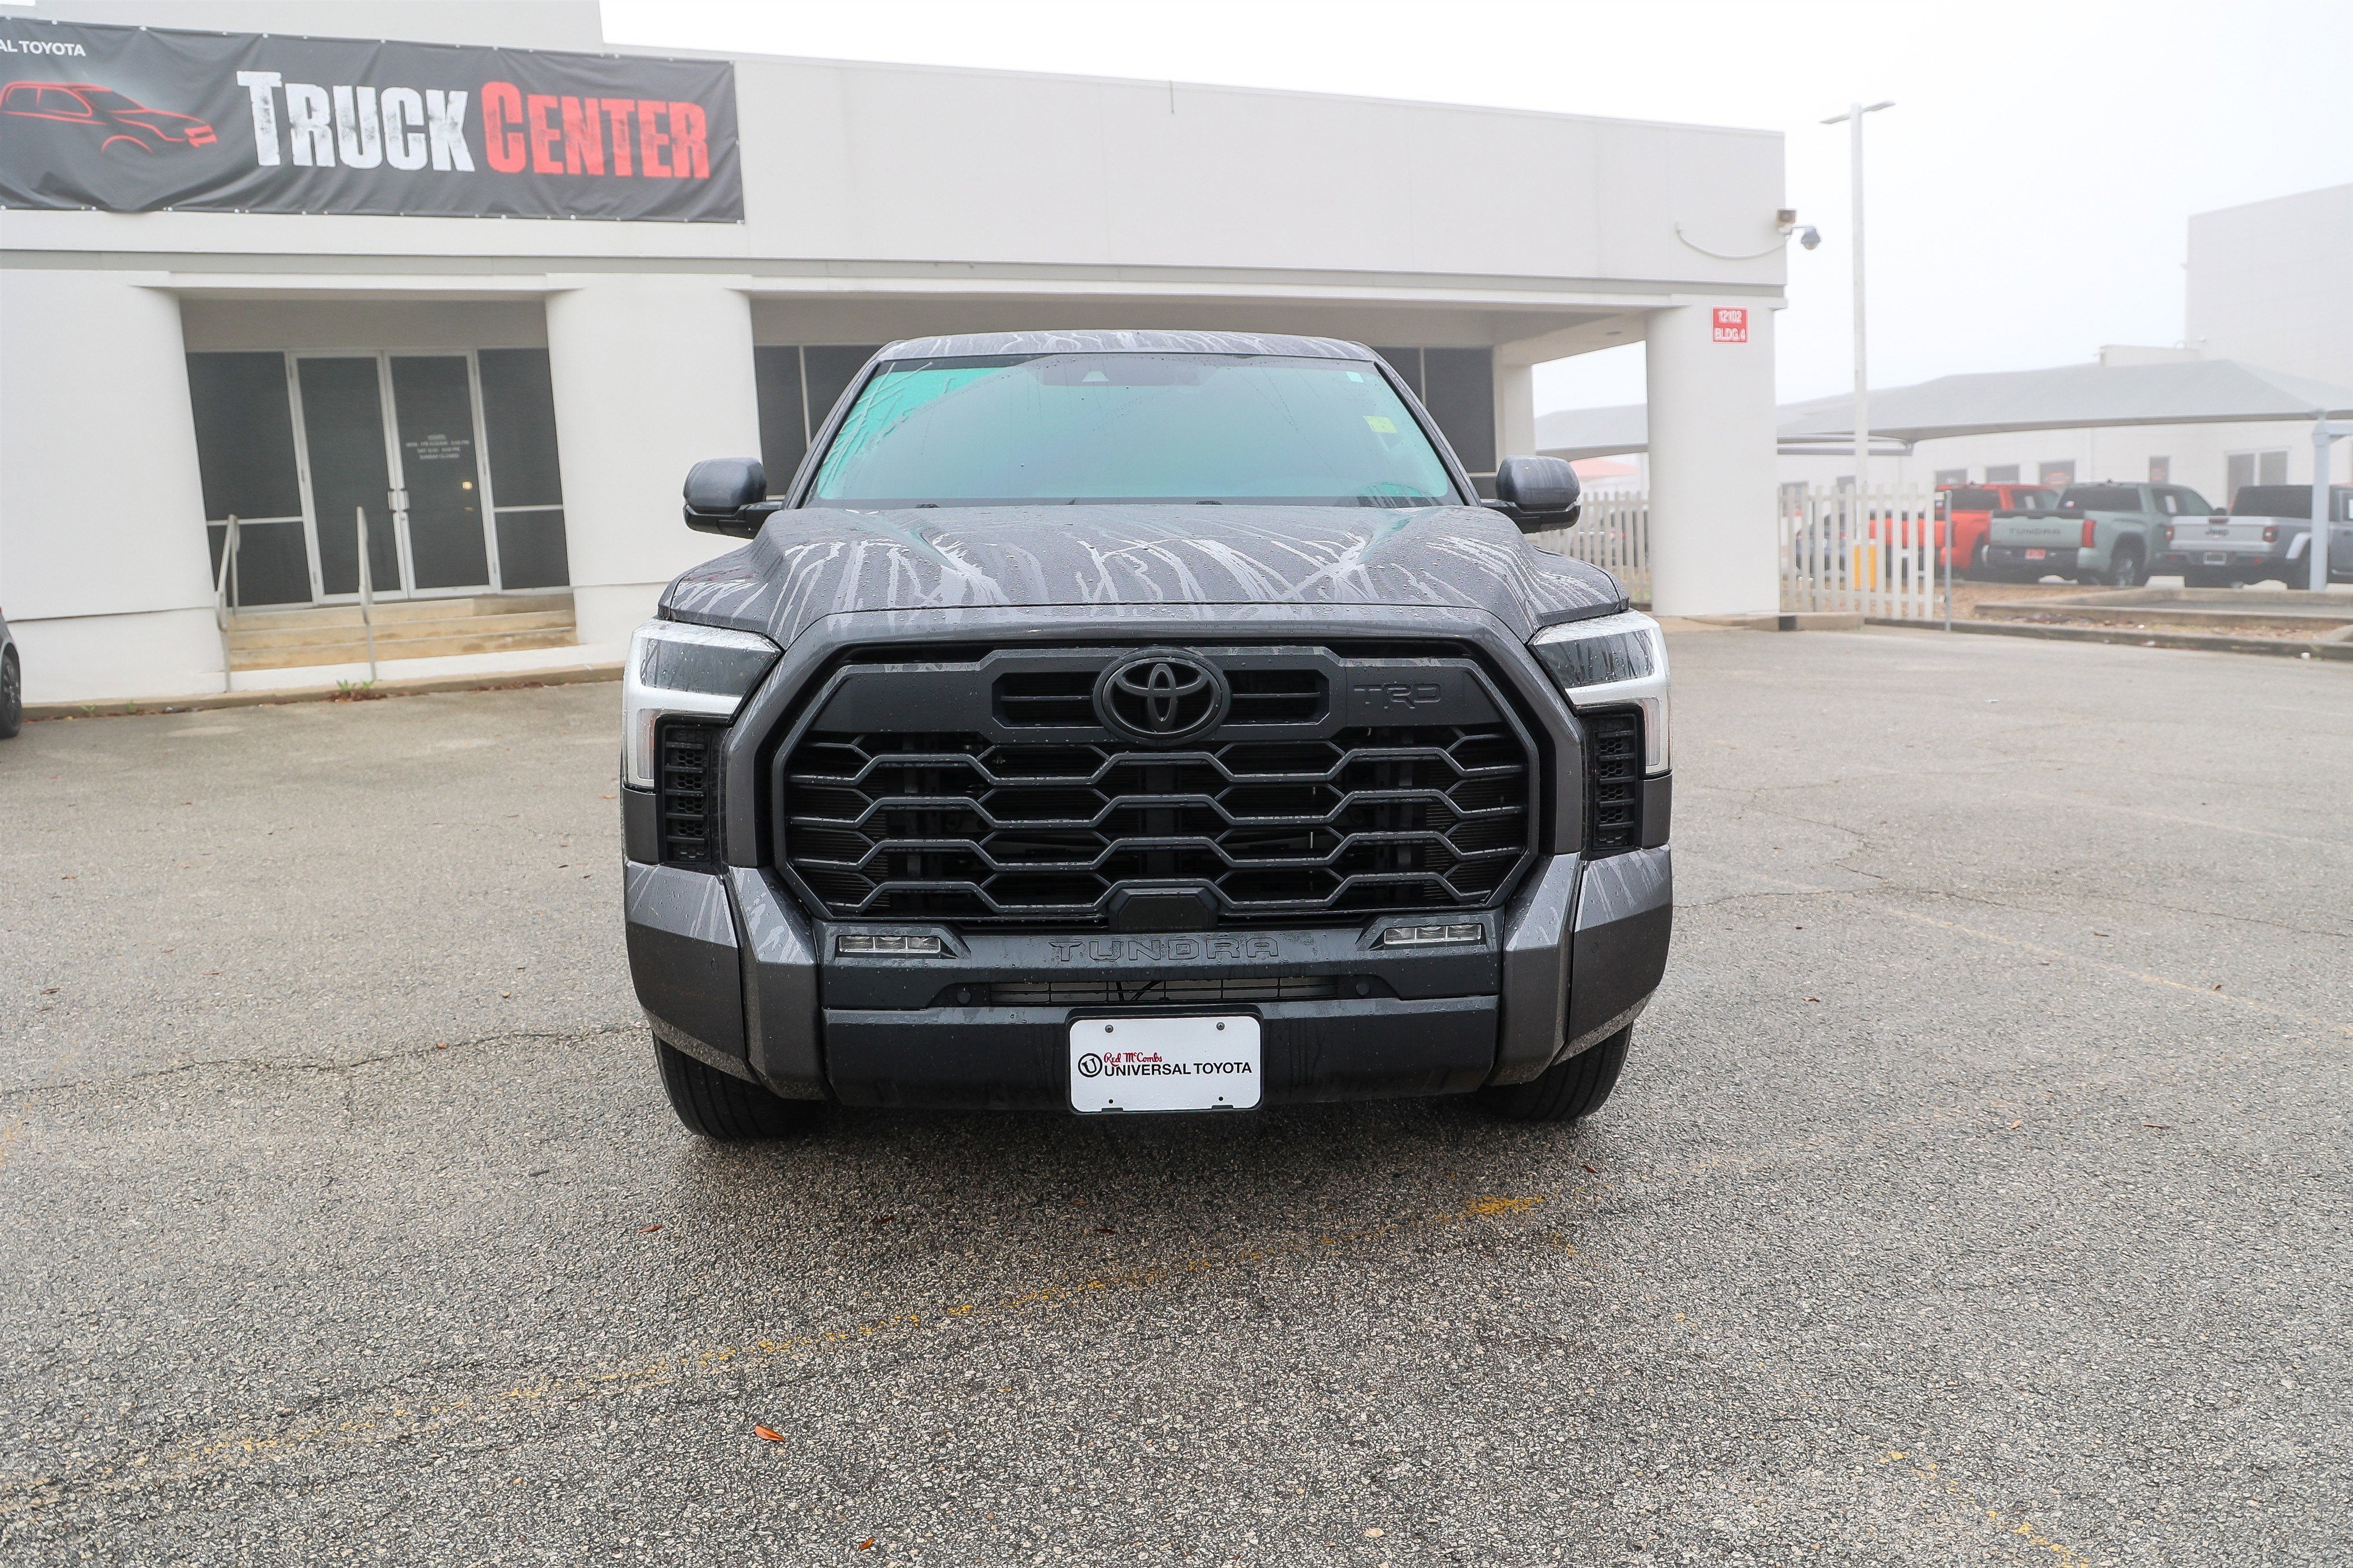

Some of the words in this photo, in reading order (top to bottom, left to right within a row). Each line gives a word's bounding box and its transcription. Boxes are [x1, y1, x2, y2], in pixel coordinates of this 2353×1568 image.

[18, 40, 86, 57] TOYOTA
[236, 71, 476, 172] TRUCK
[481, 81, 710, 179] CENTER
[1718, 310, 1743, 323] 12102
[1353, 683, 1441, 709] TRD
[1048, 937, 1279, 962] TUNDRA
[1104, 1052, 1121, 1067] Red
[1123, 1052, 1162, 1063] McCombs
[1104, 1063, 1191, 1076] UNIVERSAL
[1193, 1062, 1252, 1075] TOYOTA
